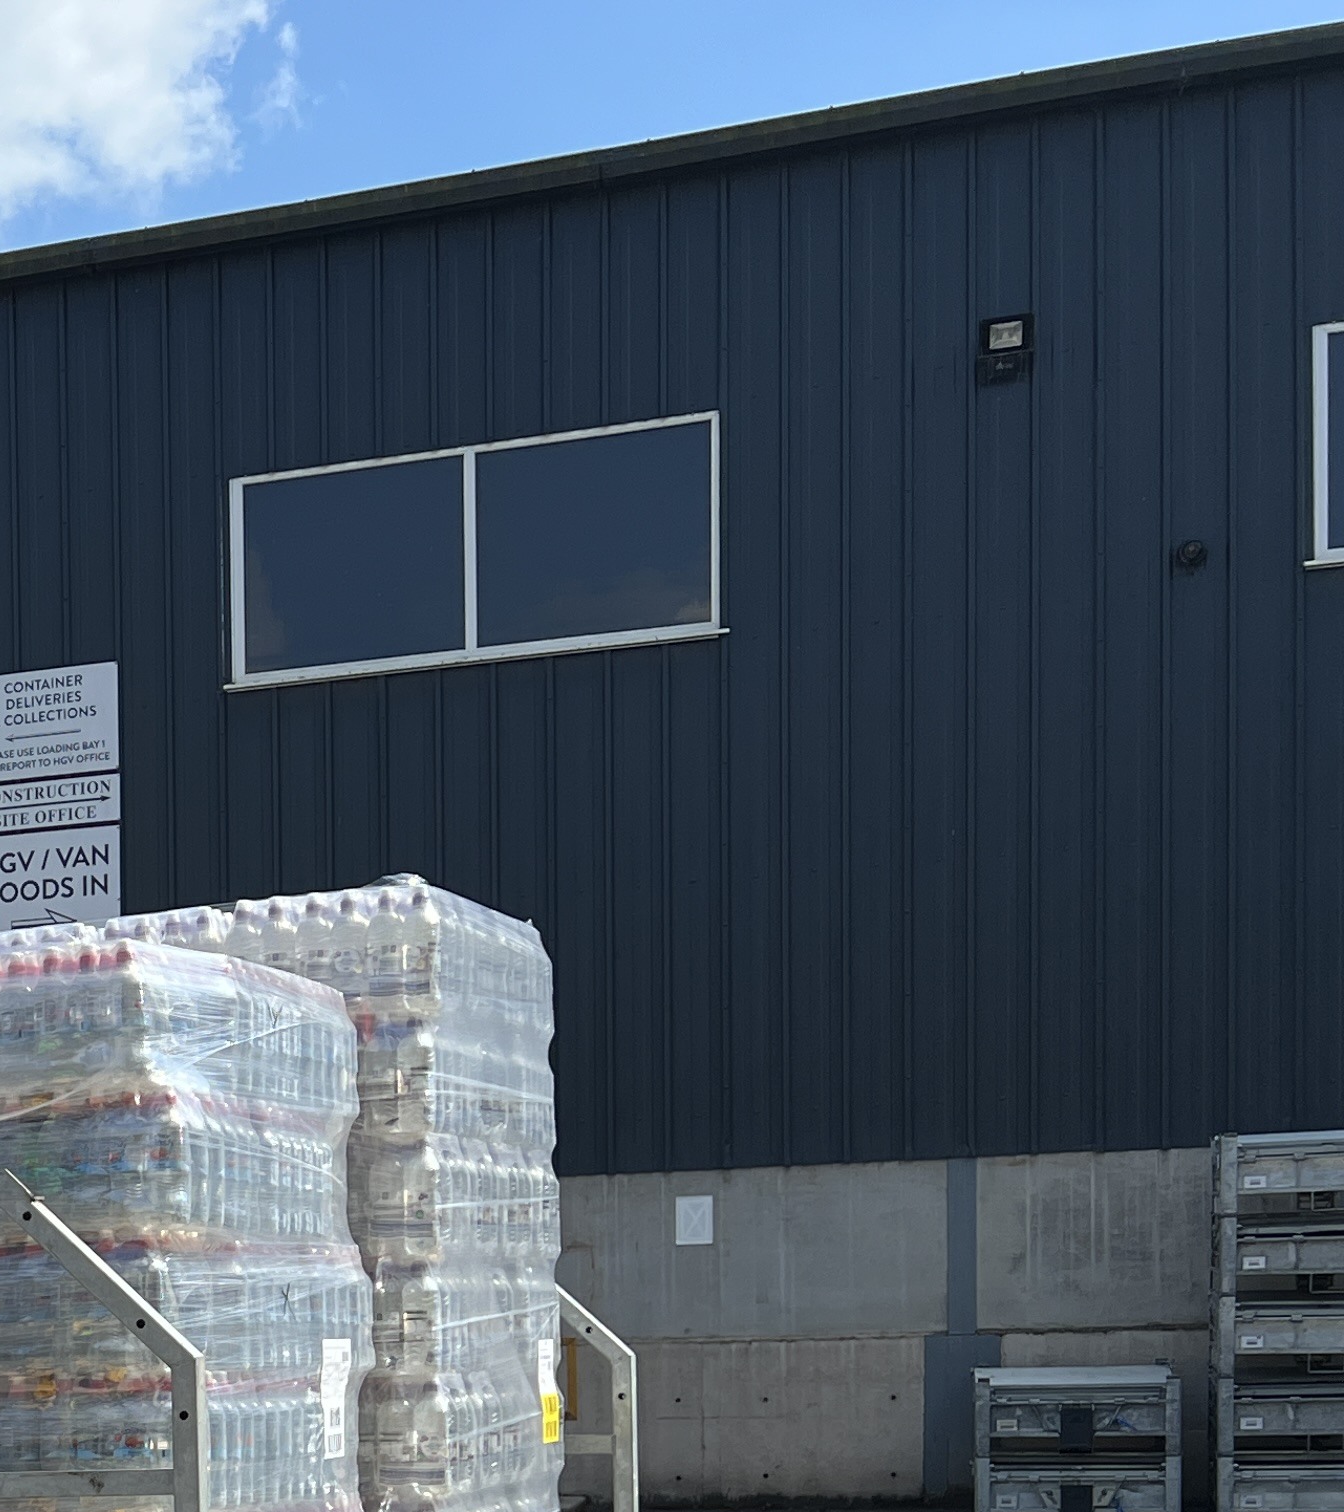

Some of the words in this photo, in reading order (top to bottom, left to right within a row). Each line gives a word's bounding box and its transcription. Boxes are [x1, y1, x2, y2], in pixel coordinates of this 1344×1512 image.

[4, 674, 83, 694] CONTAINER
[5, 690, 82, 711] DELIVERIES
[4, 705, 97, 727] COLLECTIONS
[16, 746, 35, 757] USE
[36, 742, 81, 755] LOADING
[82, 740, 100, 751] BAY
[0, 759, 37, 772] REPORT
[37, 757, 52, 768] TO
[53, 755, 75, 766] HGV
[76, 751, 111, 763] OFFICE
[34, 805, 97, 825] OFFICE
[41, 849, 50, 871] /
[56, 843, 110, 869] VAN
[82, 874, 109, 897] IN
